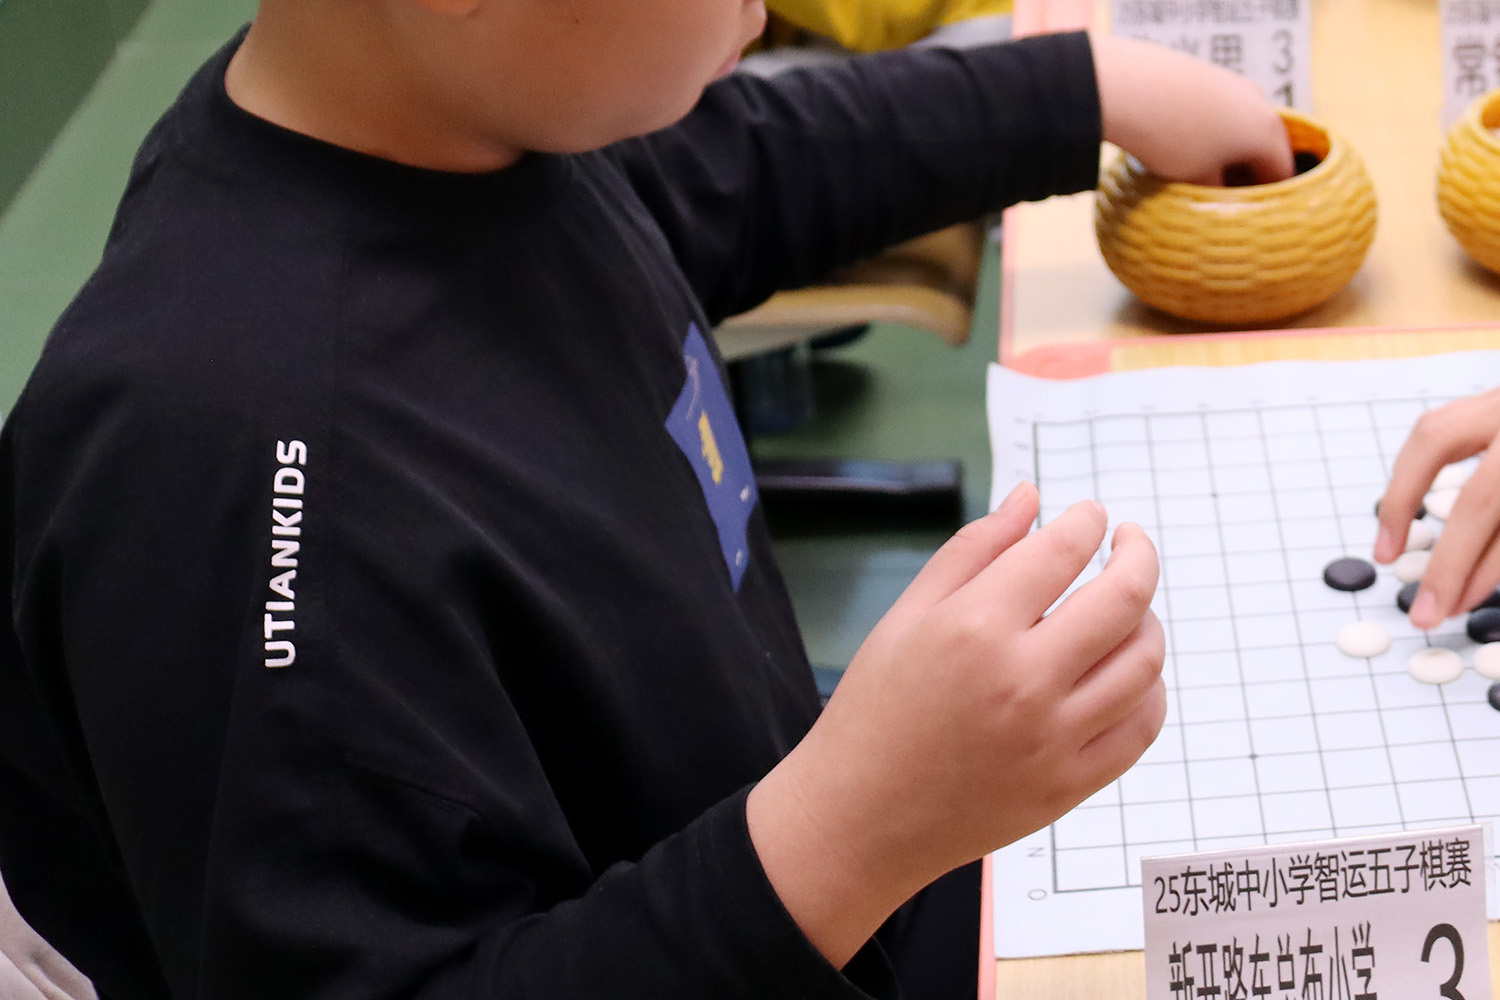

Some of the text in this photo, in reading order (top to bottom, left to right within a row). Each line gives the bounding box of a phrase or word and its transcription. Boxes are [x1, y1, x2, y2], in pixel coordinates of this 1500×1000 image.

[1271, 28, 1294, 75] 3
[264, 439, 308, 668] UTIANKIDS
[1154, 837, 1472, 916] 25东城中小学智运五子棋赛
[1420, 922, 1466, 1000] 3
